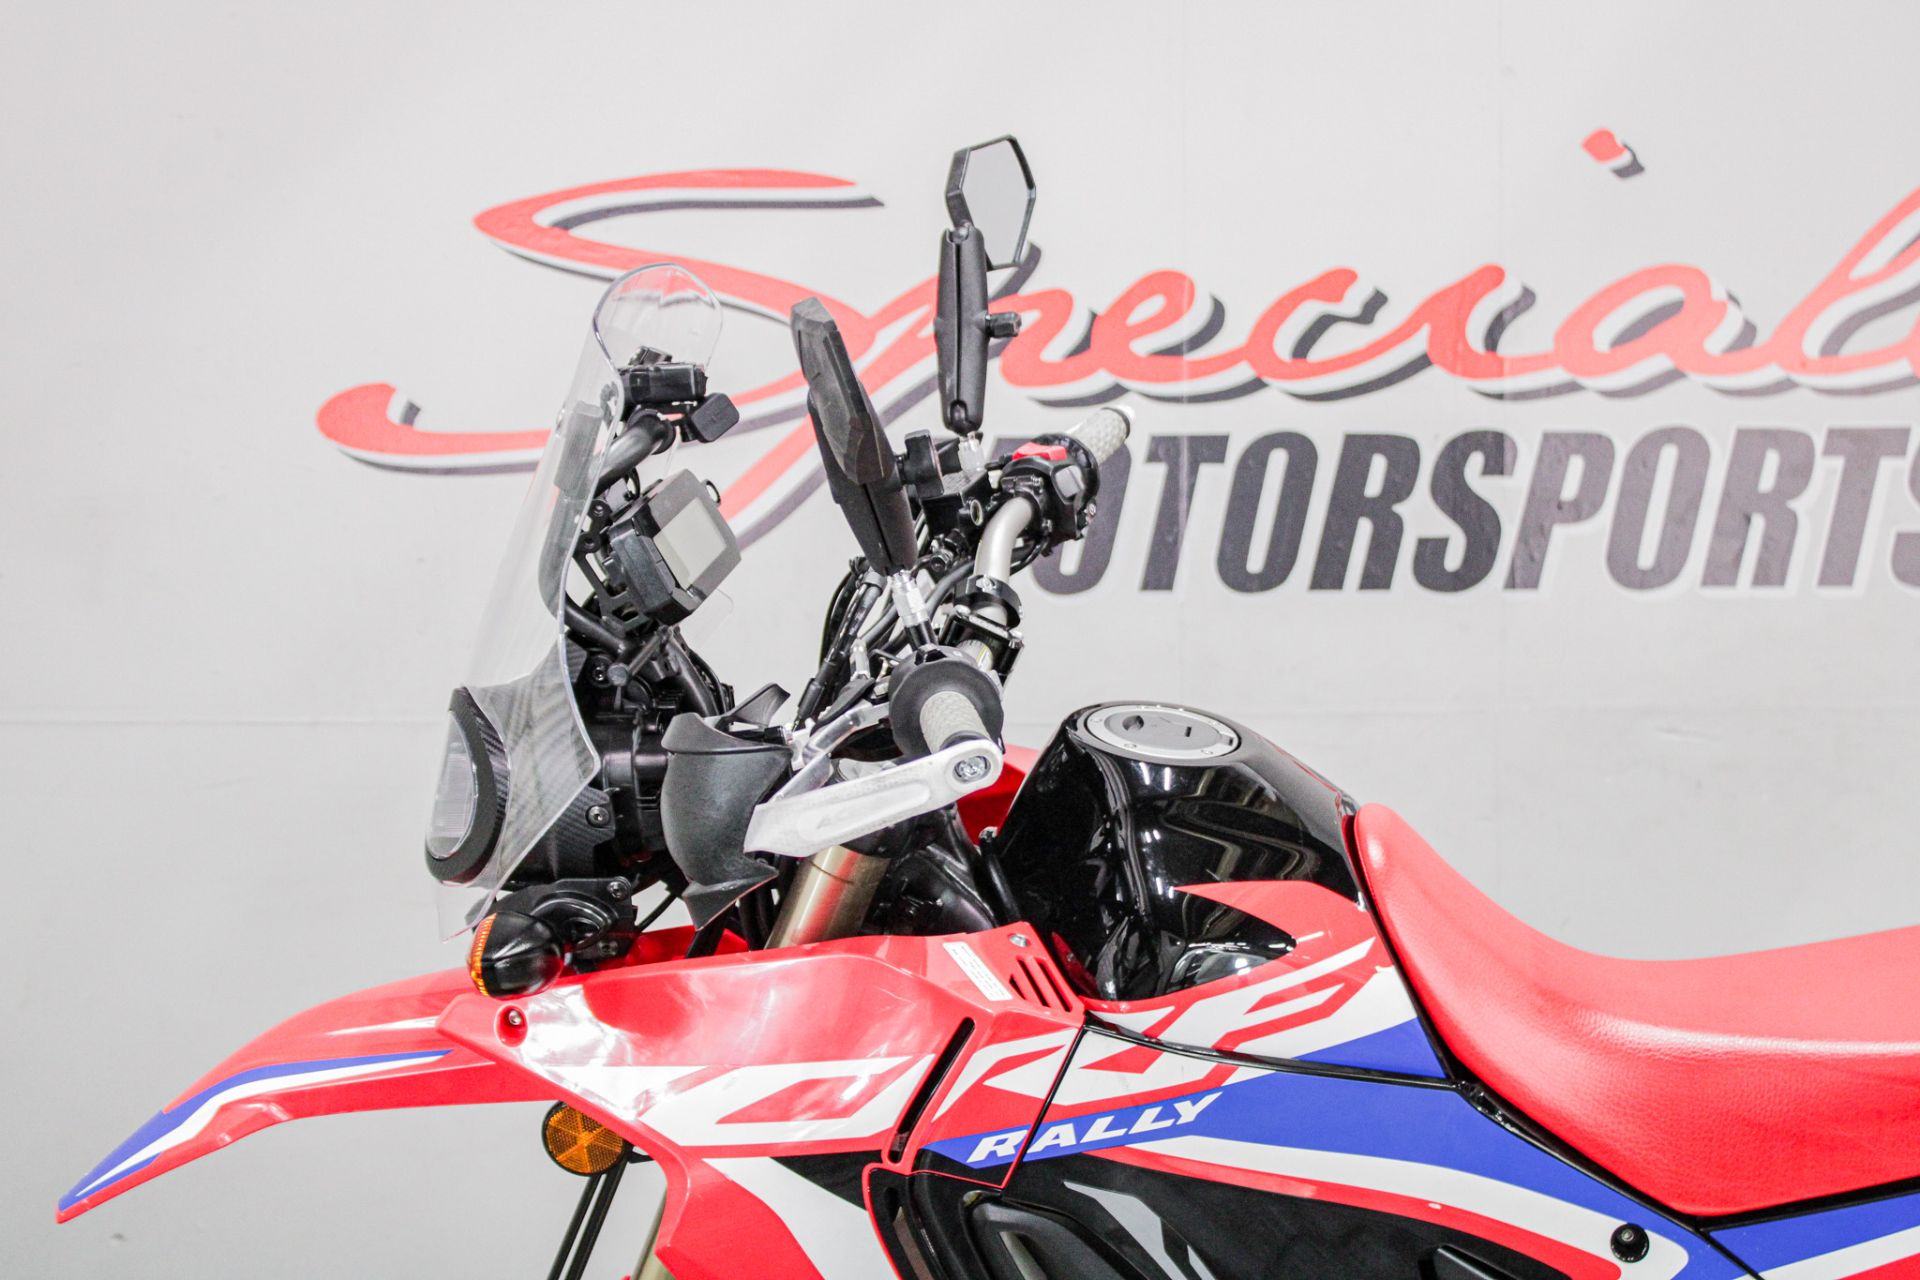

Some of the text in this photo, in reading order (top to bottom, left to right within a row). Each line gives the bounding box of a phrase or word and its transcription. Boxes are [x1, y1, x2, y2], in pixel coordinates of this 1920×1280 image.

[316, 128, 1920, 550] Special
[928, 428, 1920, 595] OTORSPORT
[966, 1091, 1223, 1164] RALLY
